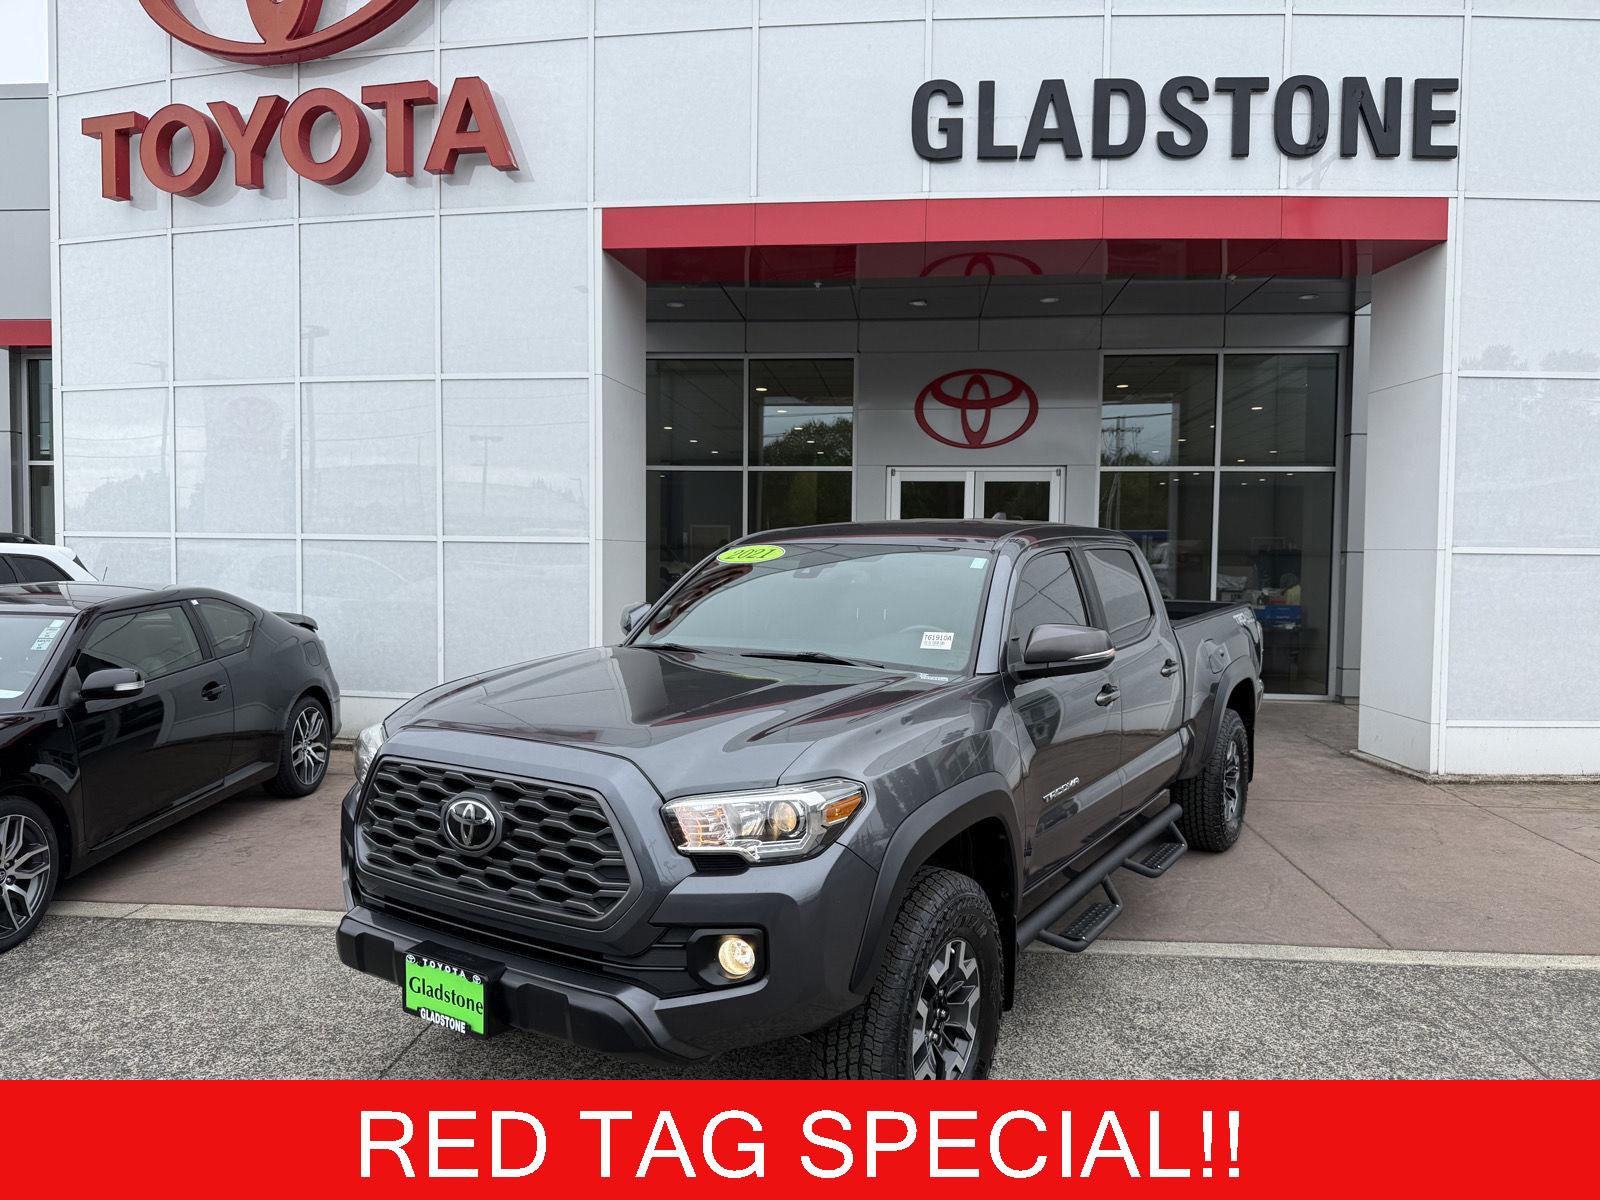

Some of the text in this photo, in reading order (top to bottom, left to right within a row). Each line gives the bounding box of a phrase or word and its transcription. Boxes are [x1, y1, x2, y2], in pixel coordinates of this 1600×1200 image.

[912, 76, 1458, 162] GLADSTONE
[83, 77, 519, 201] TOYOTA
[725, 548, 777, 560] 2021
[1042, 776, 1080, 802] TACOMA
[422, 958, 466, 979] TOYOTA
[408, 976, 484, 1015] Gladstone
[420, 1007, 466, 1034] GLADSTONE
